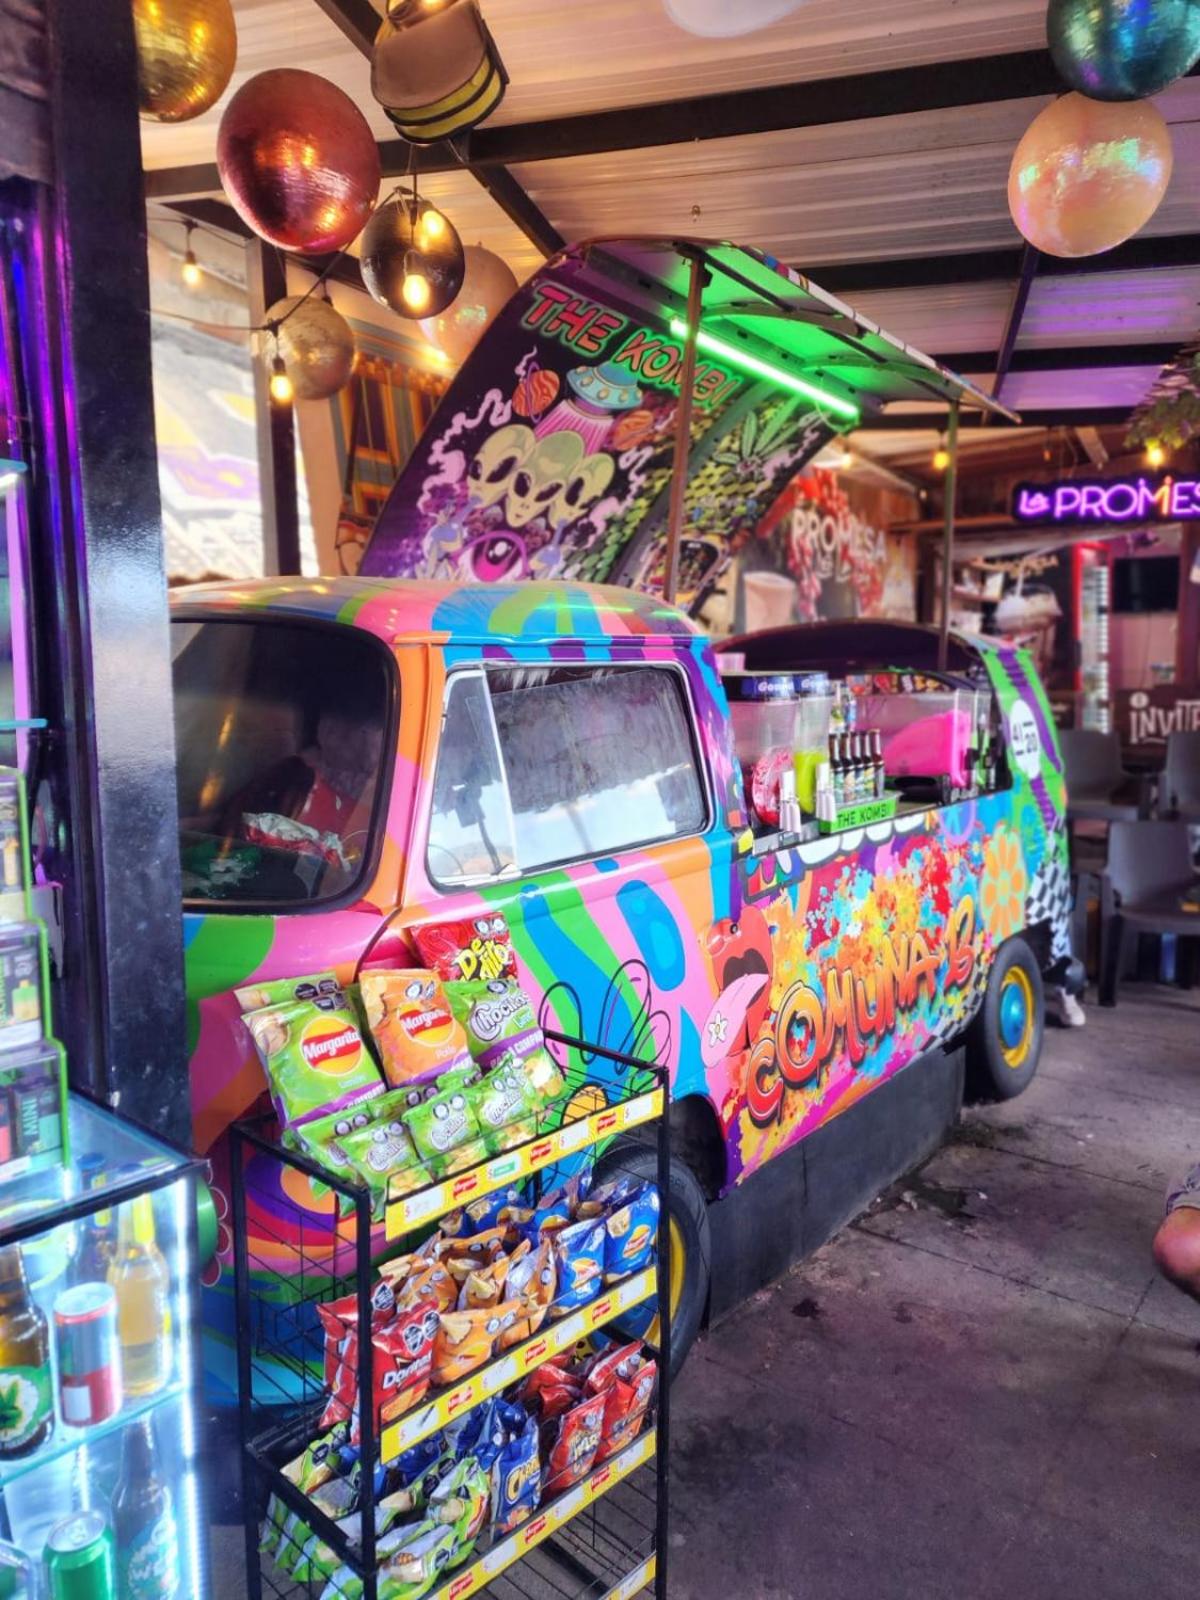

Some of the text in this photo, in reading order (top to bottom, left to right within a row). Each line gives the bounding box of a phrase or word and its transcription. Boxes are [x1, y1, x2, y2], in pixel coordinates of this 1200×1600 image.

[524, 284, 738, 406] THE KOMBI
[836, 811, 856, 827] THE
[302, 1030, 361, 1059] Margarita
[748, 931, 946, 1125] COMUNA
